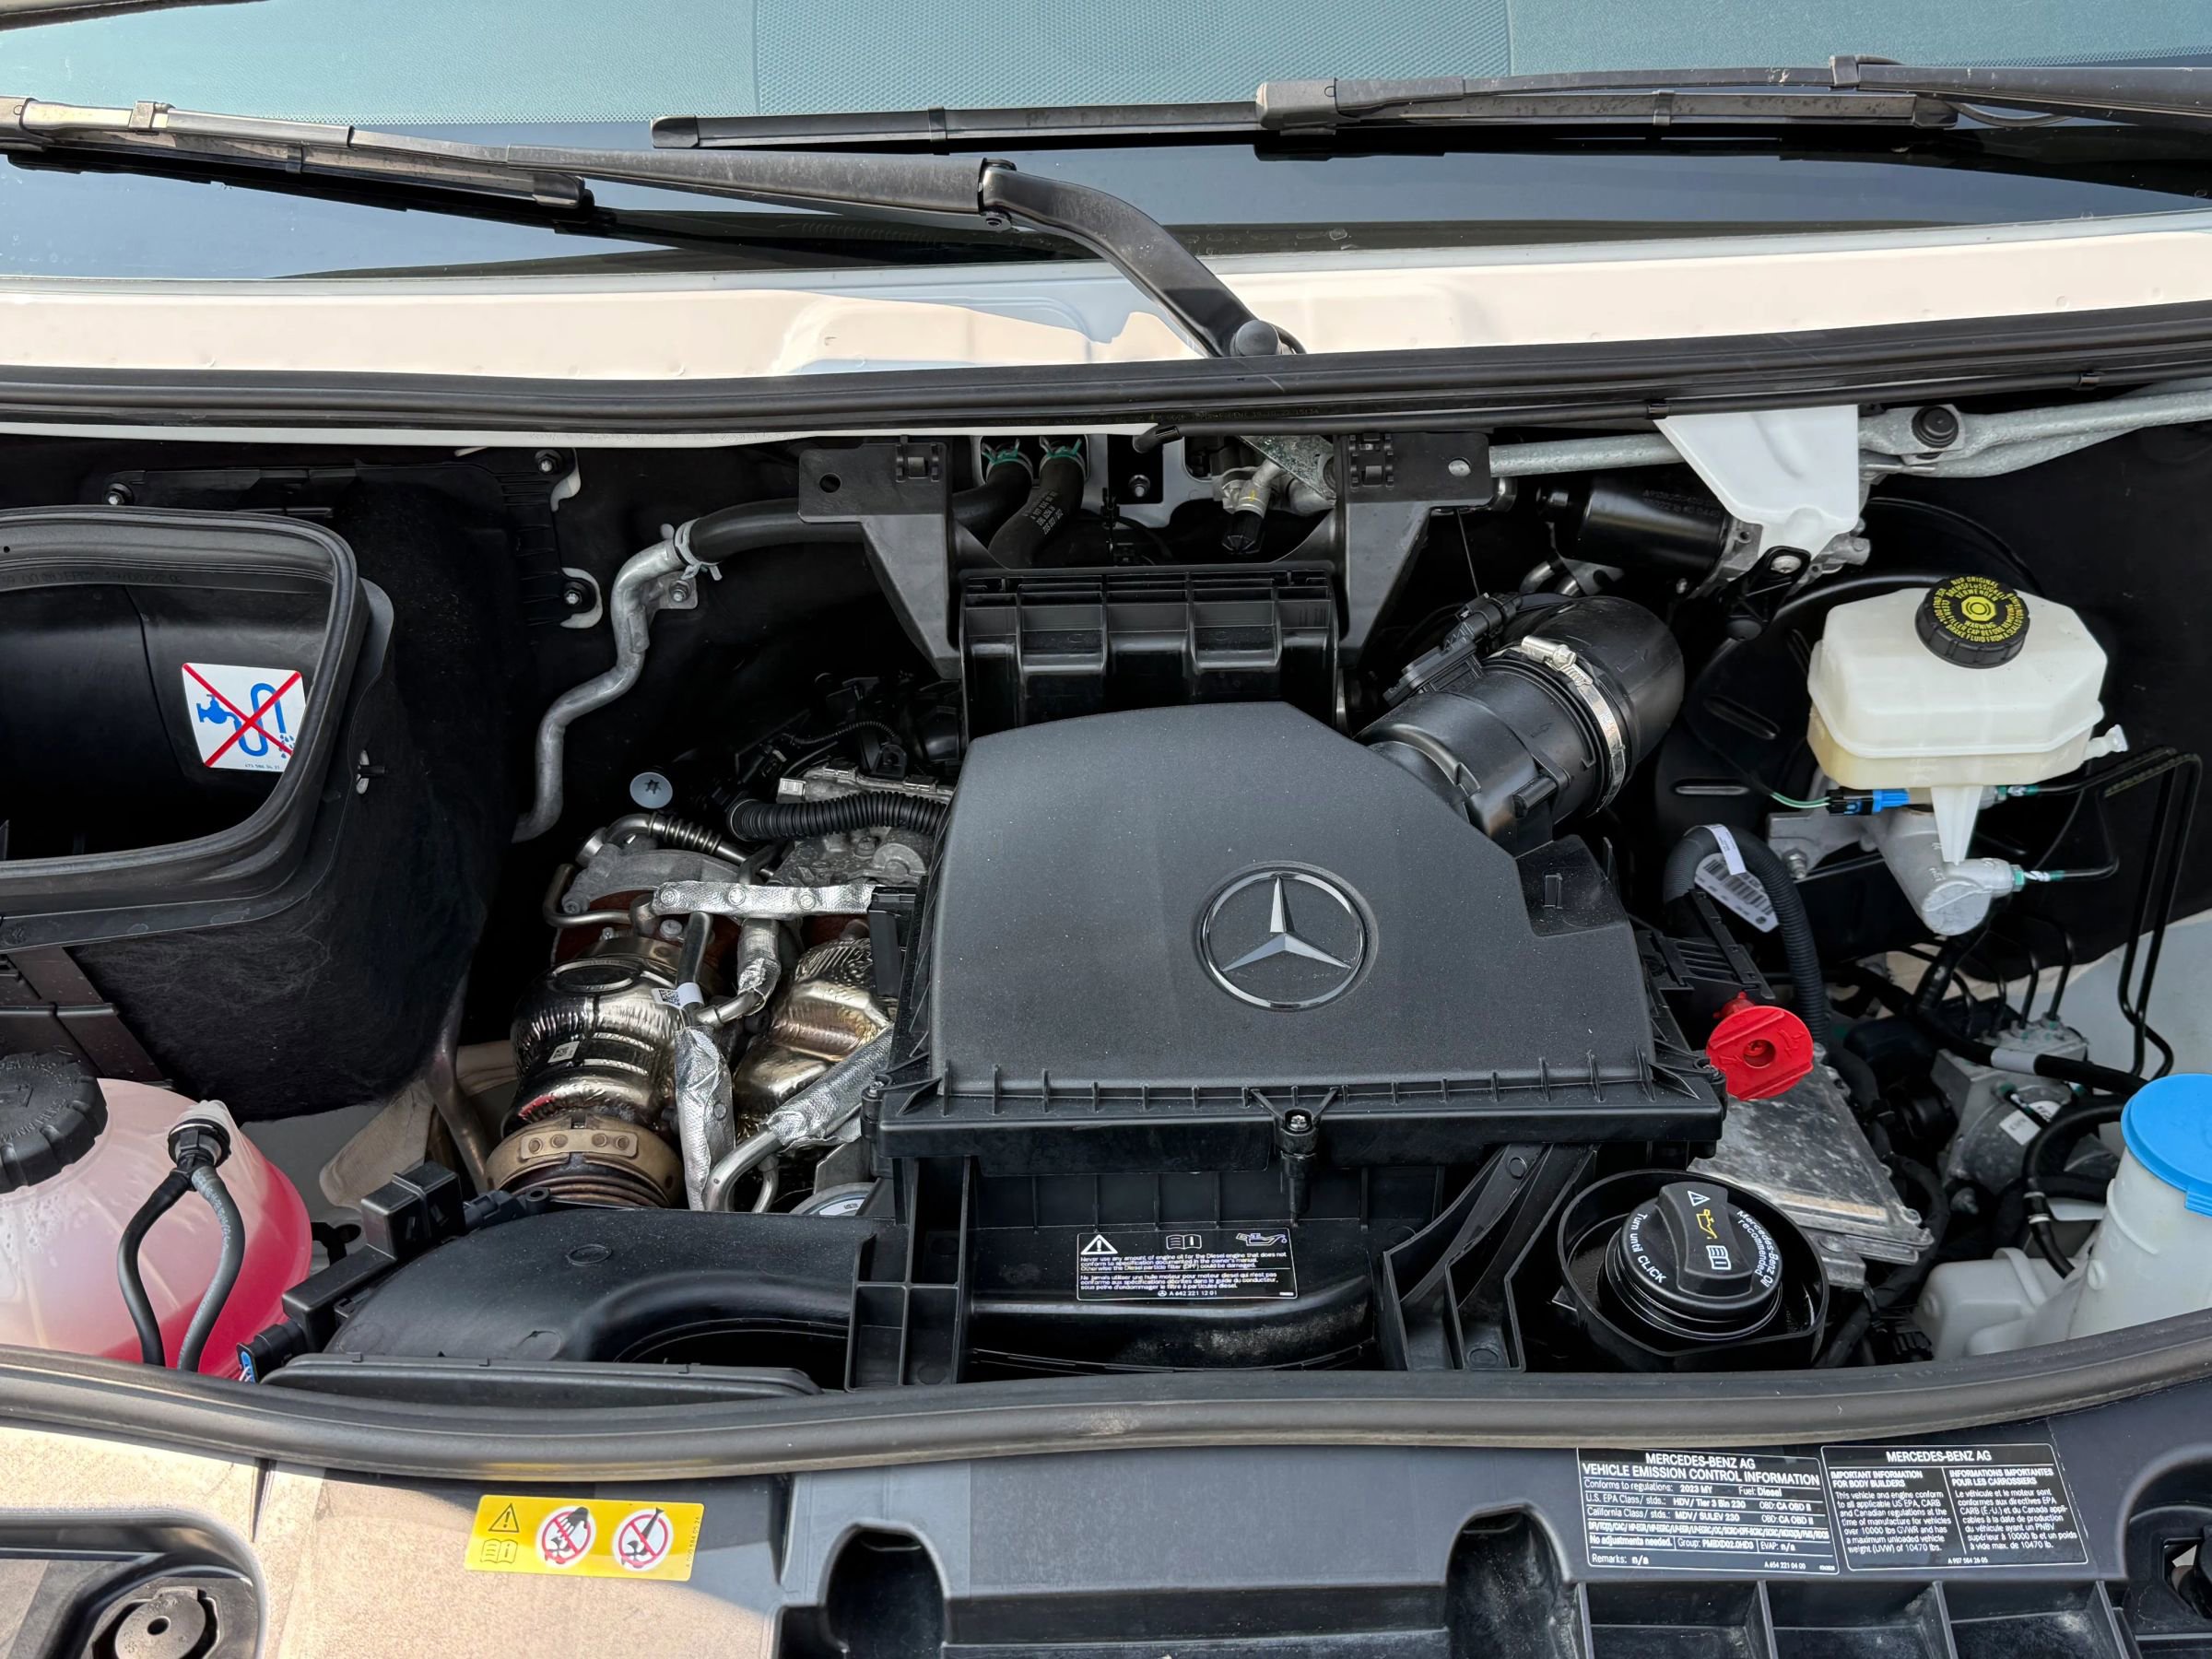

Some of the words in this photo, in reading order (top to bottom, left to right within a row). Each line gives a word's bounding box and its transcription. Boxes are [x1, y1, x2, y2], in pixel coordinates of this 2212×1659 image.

[1630, 1213, 1648, 1230] Turn
[1630, 1233, 1643, 1253] until
[1736, 1210, 1779, 1274] Mercedes-Benz
[1738, 1219, 1766, 1276] recommended
[1637, 1255, 1667, 1283] CLICK
[1645, 1453, 1737, 1469] MERCEDES-BENZ
[1740, 1458, 1756, 1470] AG
[1886, 1451, 1974, 1463] MERCEDES-BENZ
[1976, 1450, 1992, 1461] AG
[1583, 1463, 1630, 1477] VEHICLE
[1632, 1465, 1687, 1479] EMISSION
[1688, 1467, 1742, 1482] CONTROL
[1744, 1471, 1820, 1486] INFORMATION
[1830, 1471, 1872, 1479] IMPORTANT
[1873, 1470, 1924, 1478] INFORMATION
[1949, 1469, 2004, 1477] INFORMATIONS
[2004, 1468, 2054, 1477] IMPORTANTES
[1584, 1479, 1619, 1489] Conforms
[1621, 1481, 1630, 1489] to
[1631, 1482, 1674, 1492] regulations:
[1680, 1485, 1700, 1493] 2023
[1738, 1487, 1756, 1496] Fuel:
[1758, 1487, 1783, 1497] Diesel
[1832, 1480, 1849, 1488] FOR
[1870, 1479, 1906, 1488] BUILDERS
[1585, 1493, 1601, 1502] U.S.
[1604, 1494, 1618, 1503] EPA
[1619, 1495, 1643, 1504] Class/
[1673, 1497, 1695, 1507] HDV/
[1776, 1502, 1787, 1511] CA
[1788, 1502, 1805, 1511] OBD
[1587, 1507, 1622, 1517] California
[1624, 1508, 1648, 1519] Class/
[1675, 1511, 1698, 1521] MDV/
[1700, 1512, 1724, 1522] SULEV
[1779, 1515, 1790, 1524] CA
[1791, 1516, 1807, 1524] OBD
[1592, 1553, 1628, 1564] Remarks:
[1631, 1555, 1649, 1565] n/a
